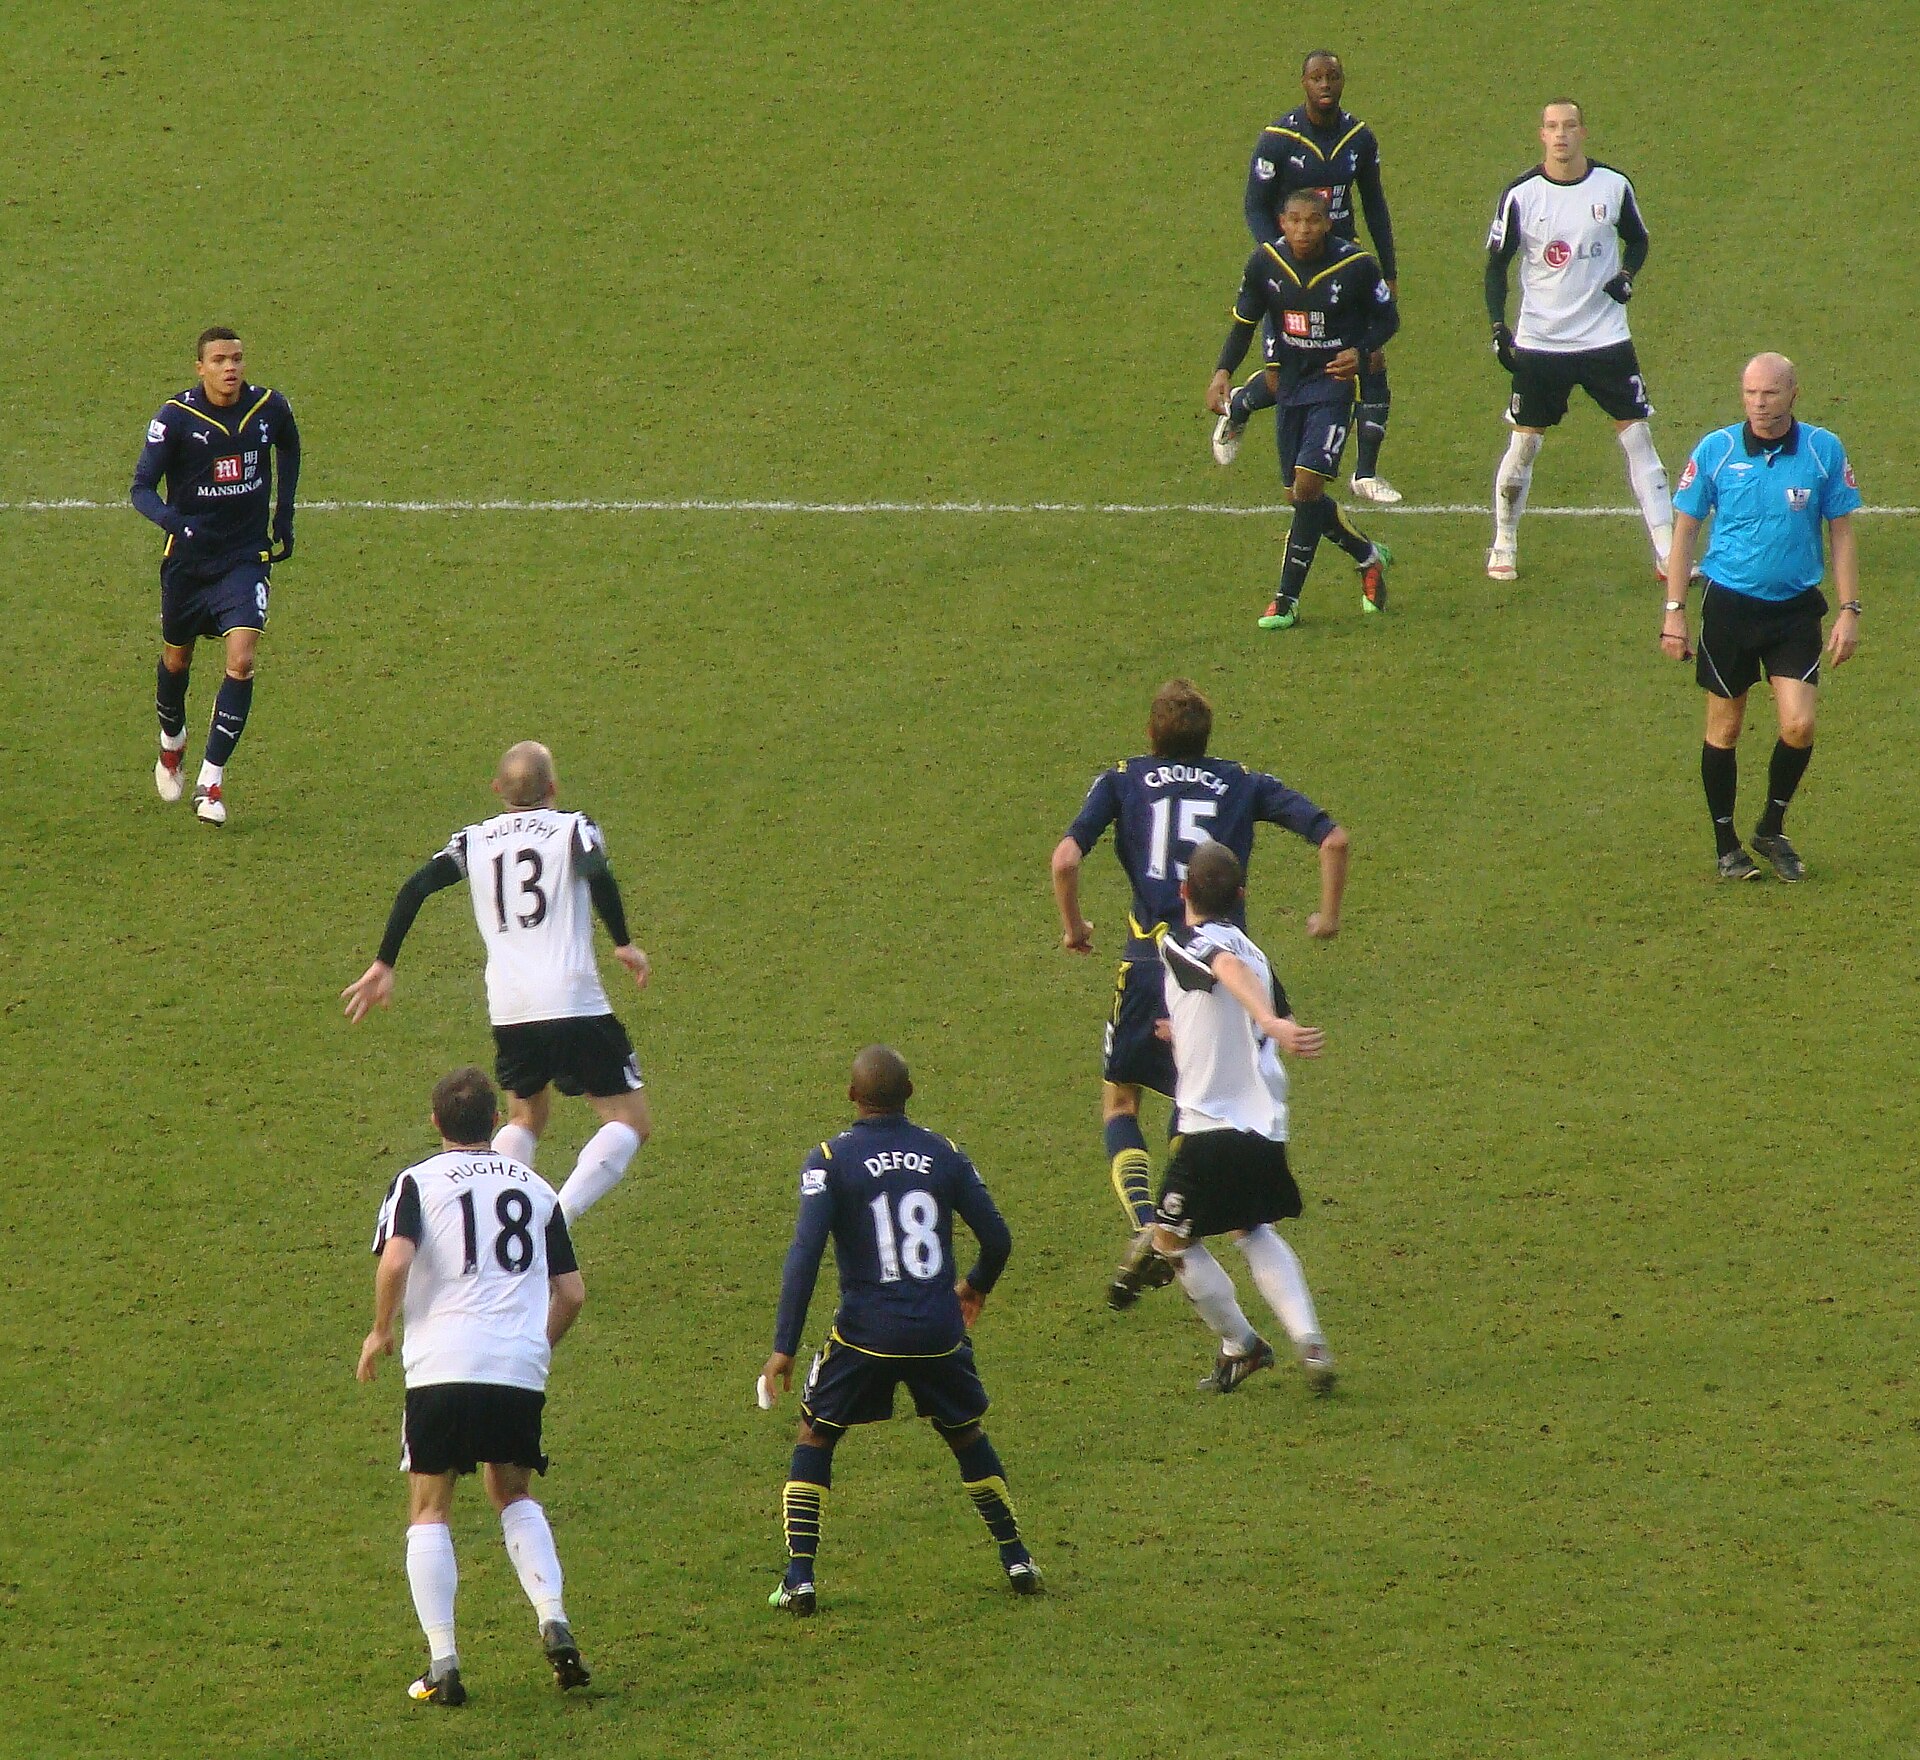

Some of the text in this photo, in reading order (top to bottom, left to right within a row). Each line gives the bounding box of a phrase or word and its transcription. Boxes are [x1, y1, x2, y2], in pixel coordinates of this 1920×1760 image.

[1577, 241, 1602, 260] LG
[255, 582, 267, 610] 8
[1144, 764, 1230, 796] CROUCH
[485, 817, 561, 846] MURPHY
[1146, 796, 1219, 881] 15
[491, 847, 548, 933] 13
[445, 1161, 531, 1184] HUGHES
[863, 1150, 934, 1178] DEFOE
[457, 1187, 534, 1275] 18
[869, 1188, 944, 1284] 18
